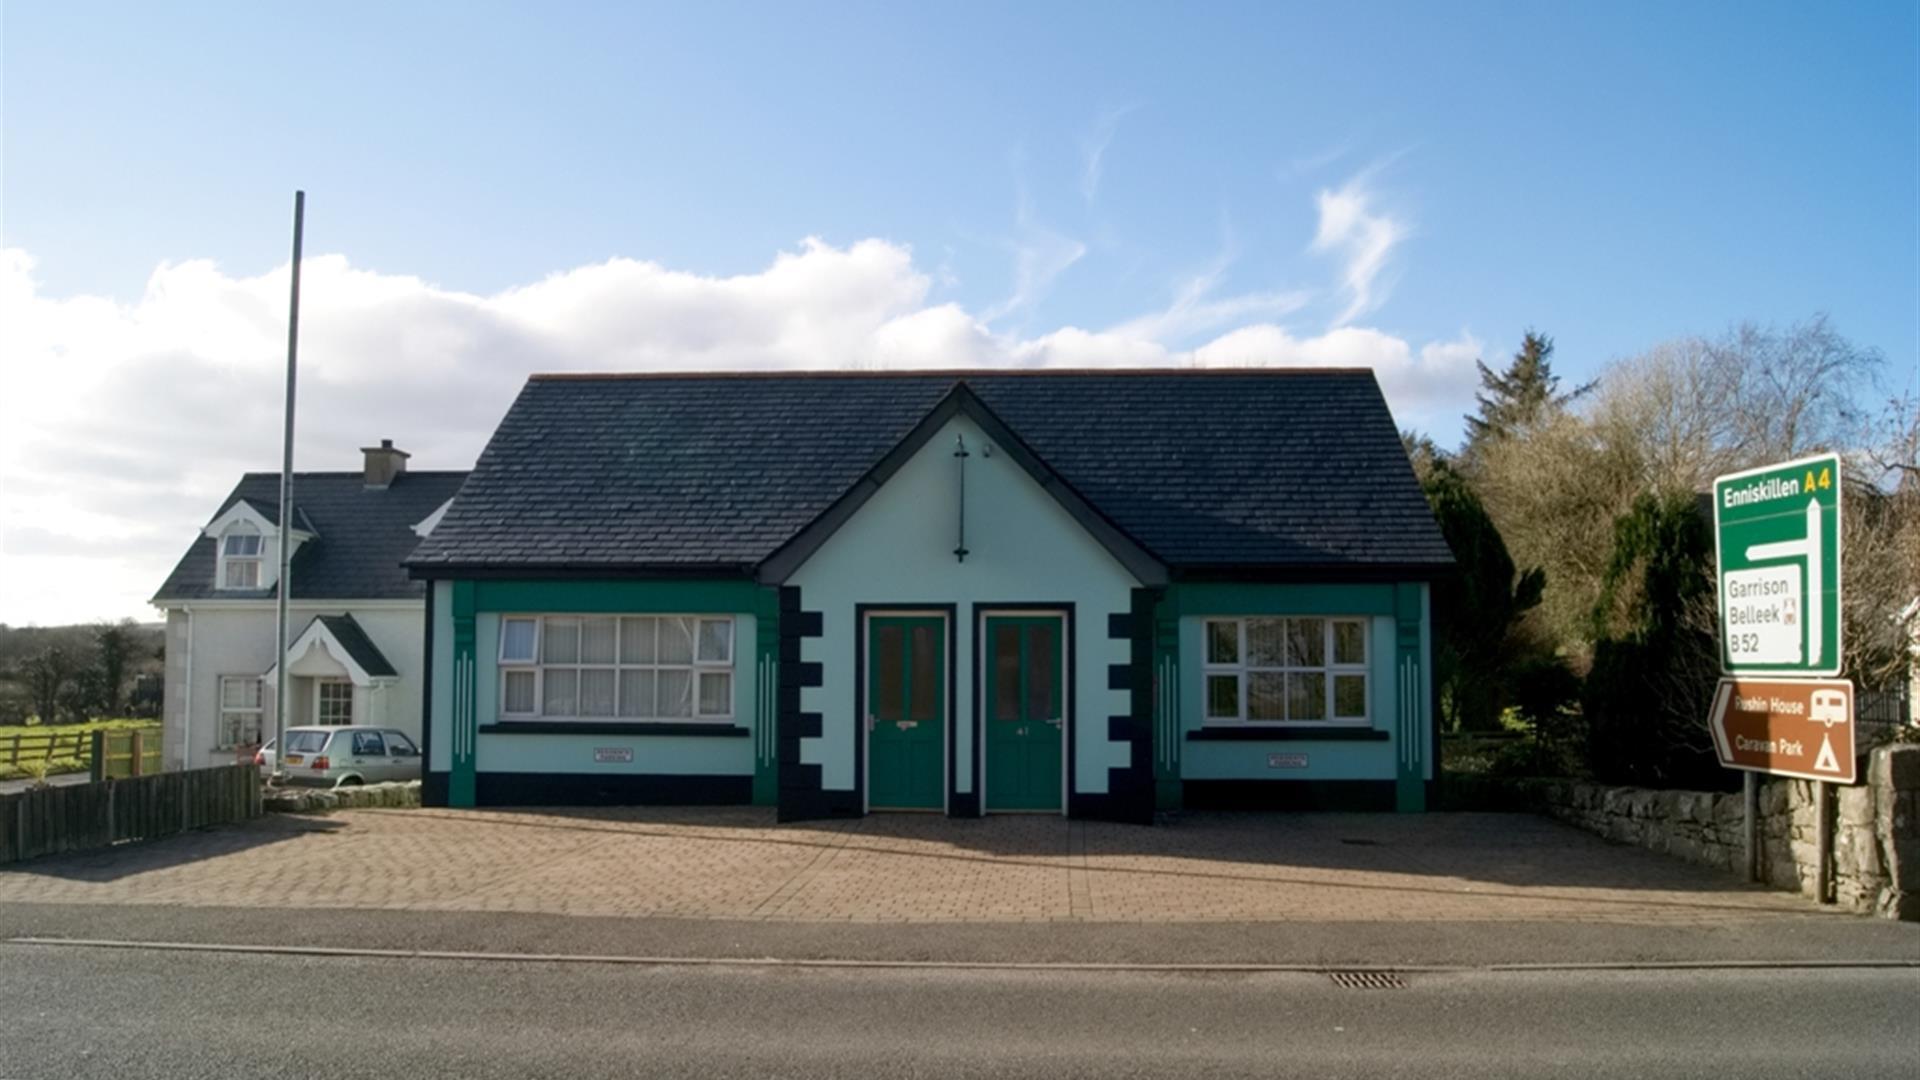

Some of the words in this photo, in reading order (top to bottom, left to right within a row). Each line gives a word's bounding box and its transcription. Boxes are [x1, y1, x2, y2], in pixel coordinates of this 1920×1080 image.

[1724, 478, 1799, 508] Enniskillen
[1728, 578, 1789, 598] Garrison
[1729, 605, 1780, 625] Belleek
[1735, 695, 1769, 713] Rushin
[1770, 697, 1804, 715] House
[1735, 734, 1777, 753] Caravan
[1779, 738, 1804, 756] Park
